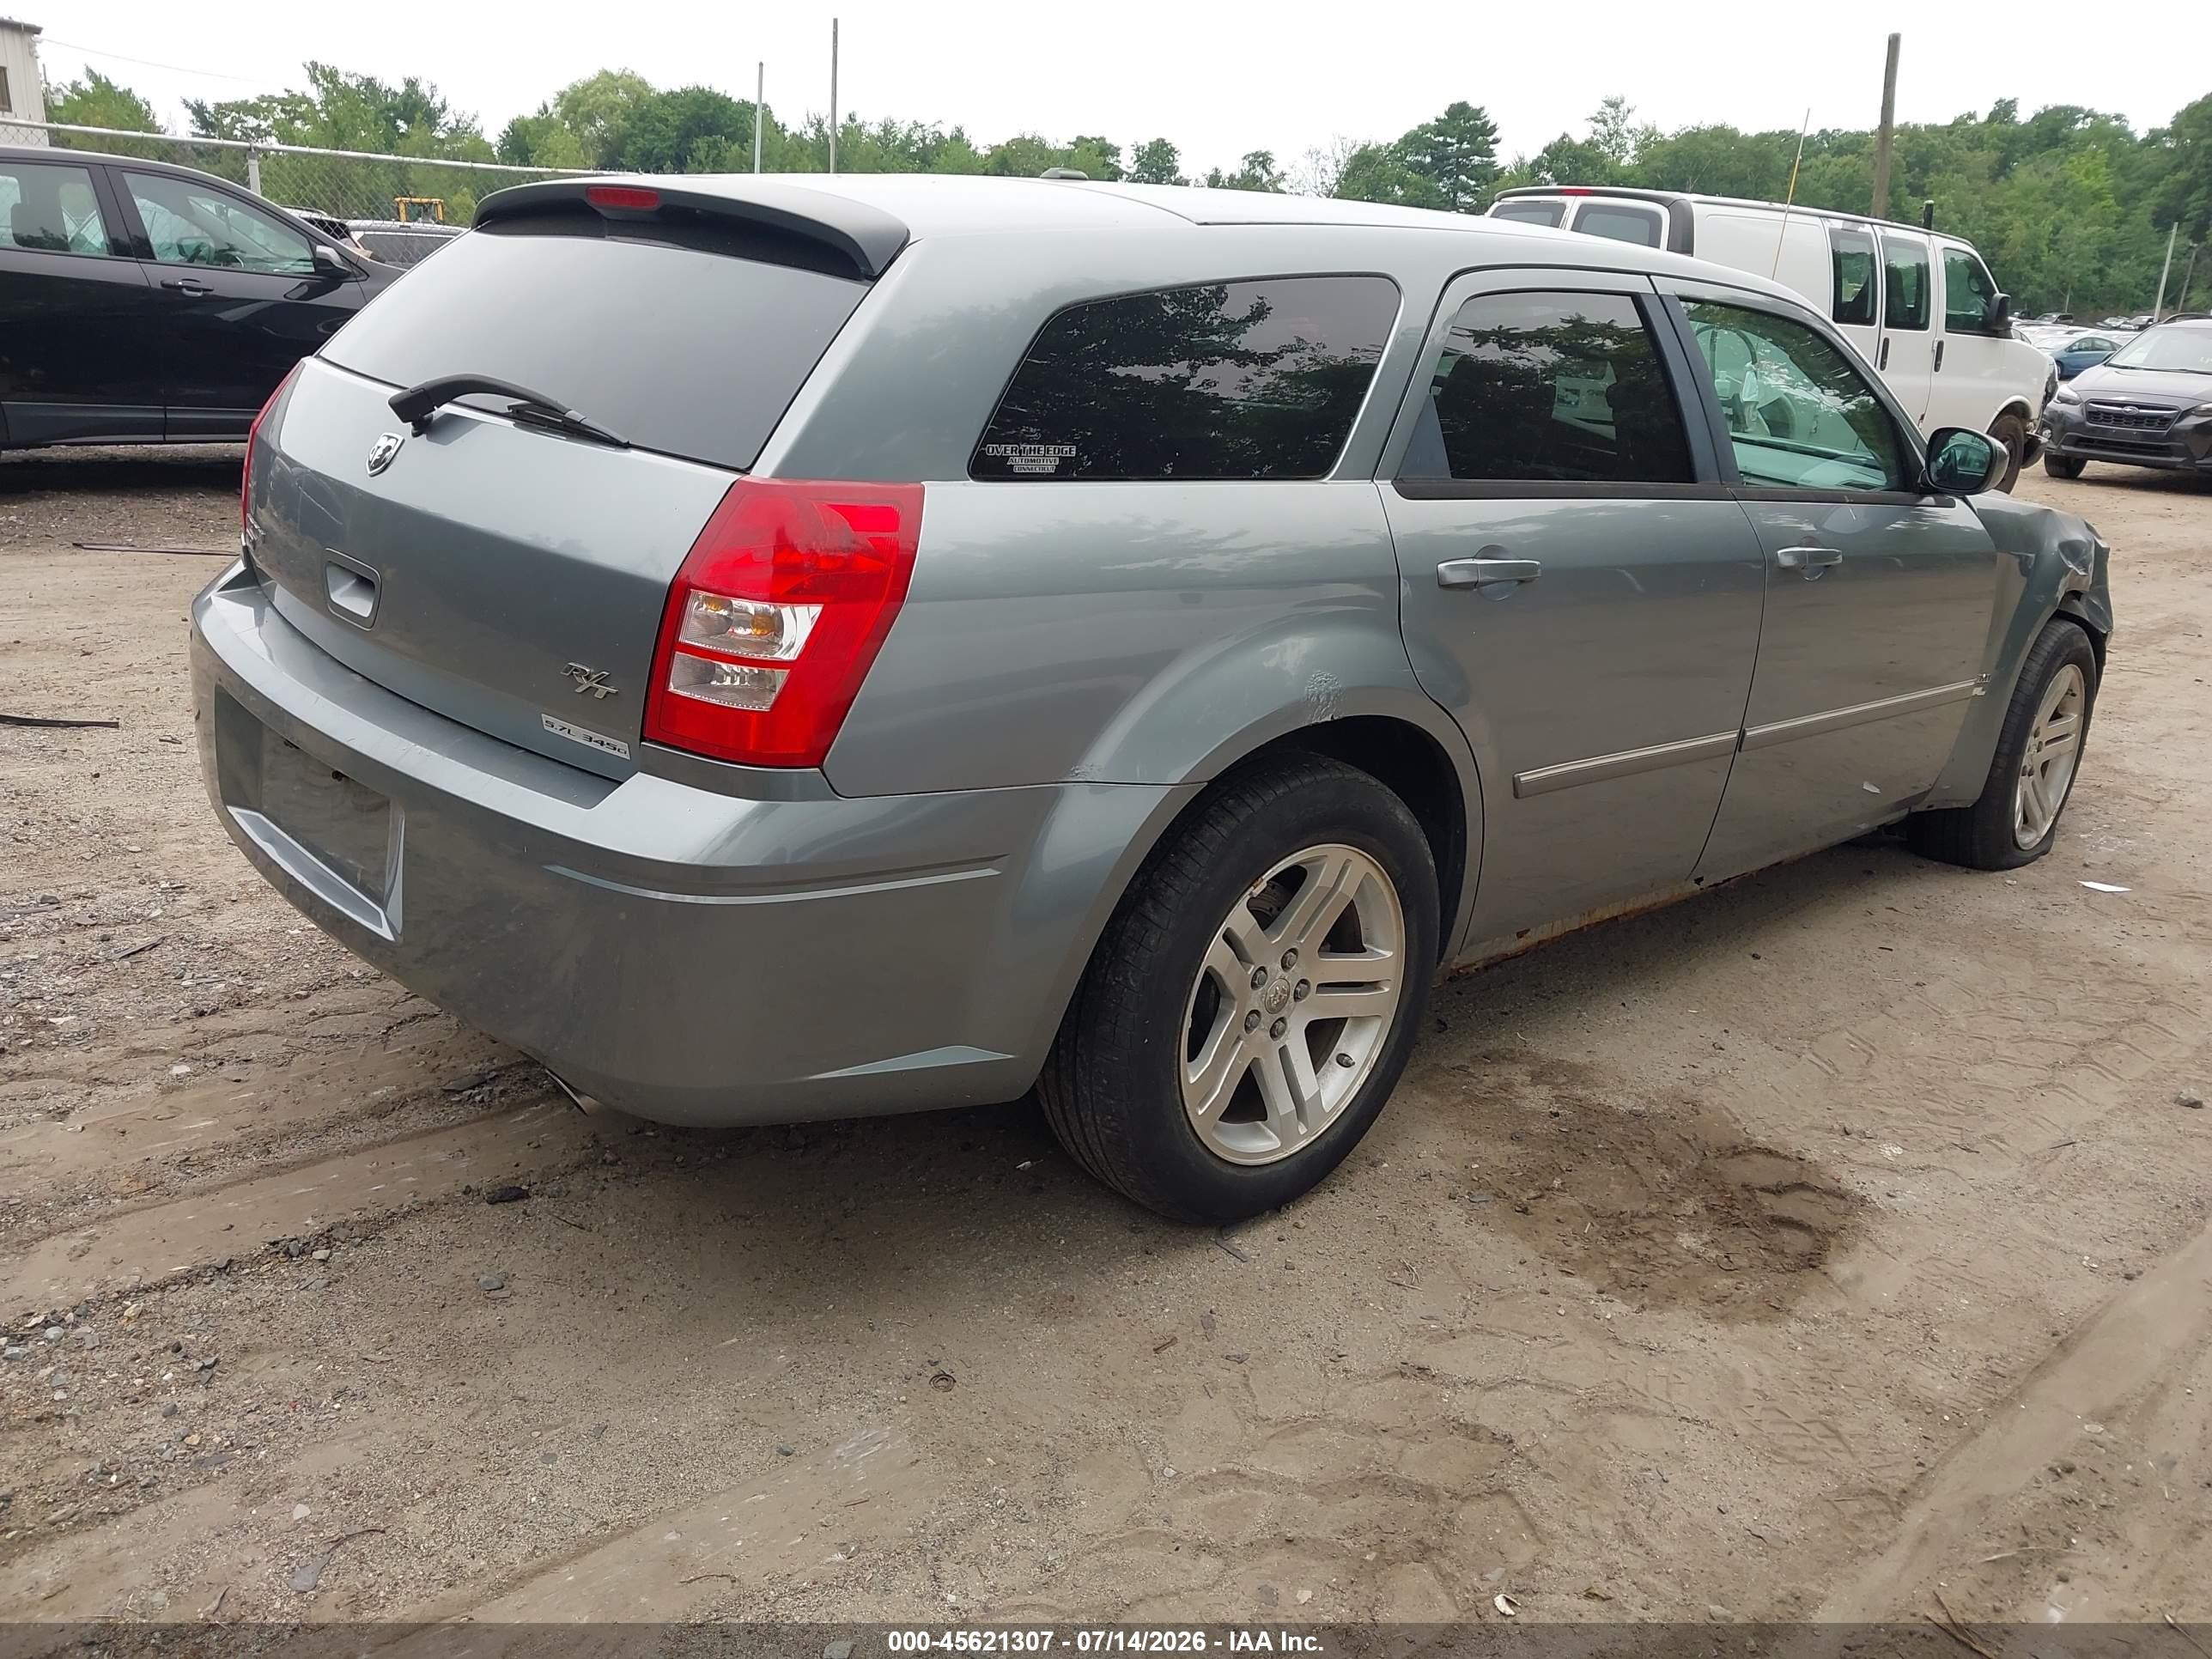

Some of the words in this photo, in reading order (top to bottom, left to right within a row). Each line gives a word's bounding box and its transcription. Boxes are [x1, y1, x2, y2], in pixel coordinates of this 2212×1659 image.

[986, 444, 1019, 456] OVER
[1020, 444, 1044, 456] THE
[1045, 445, 1077, 457] EDGE
[1006, 457, 1060, 465] AUTOMOTIVE
[560, 661, 618, 699] R/T
[544, 720, 576, 738] 5.7L
